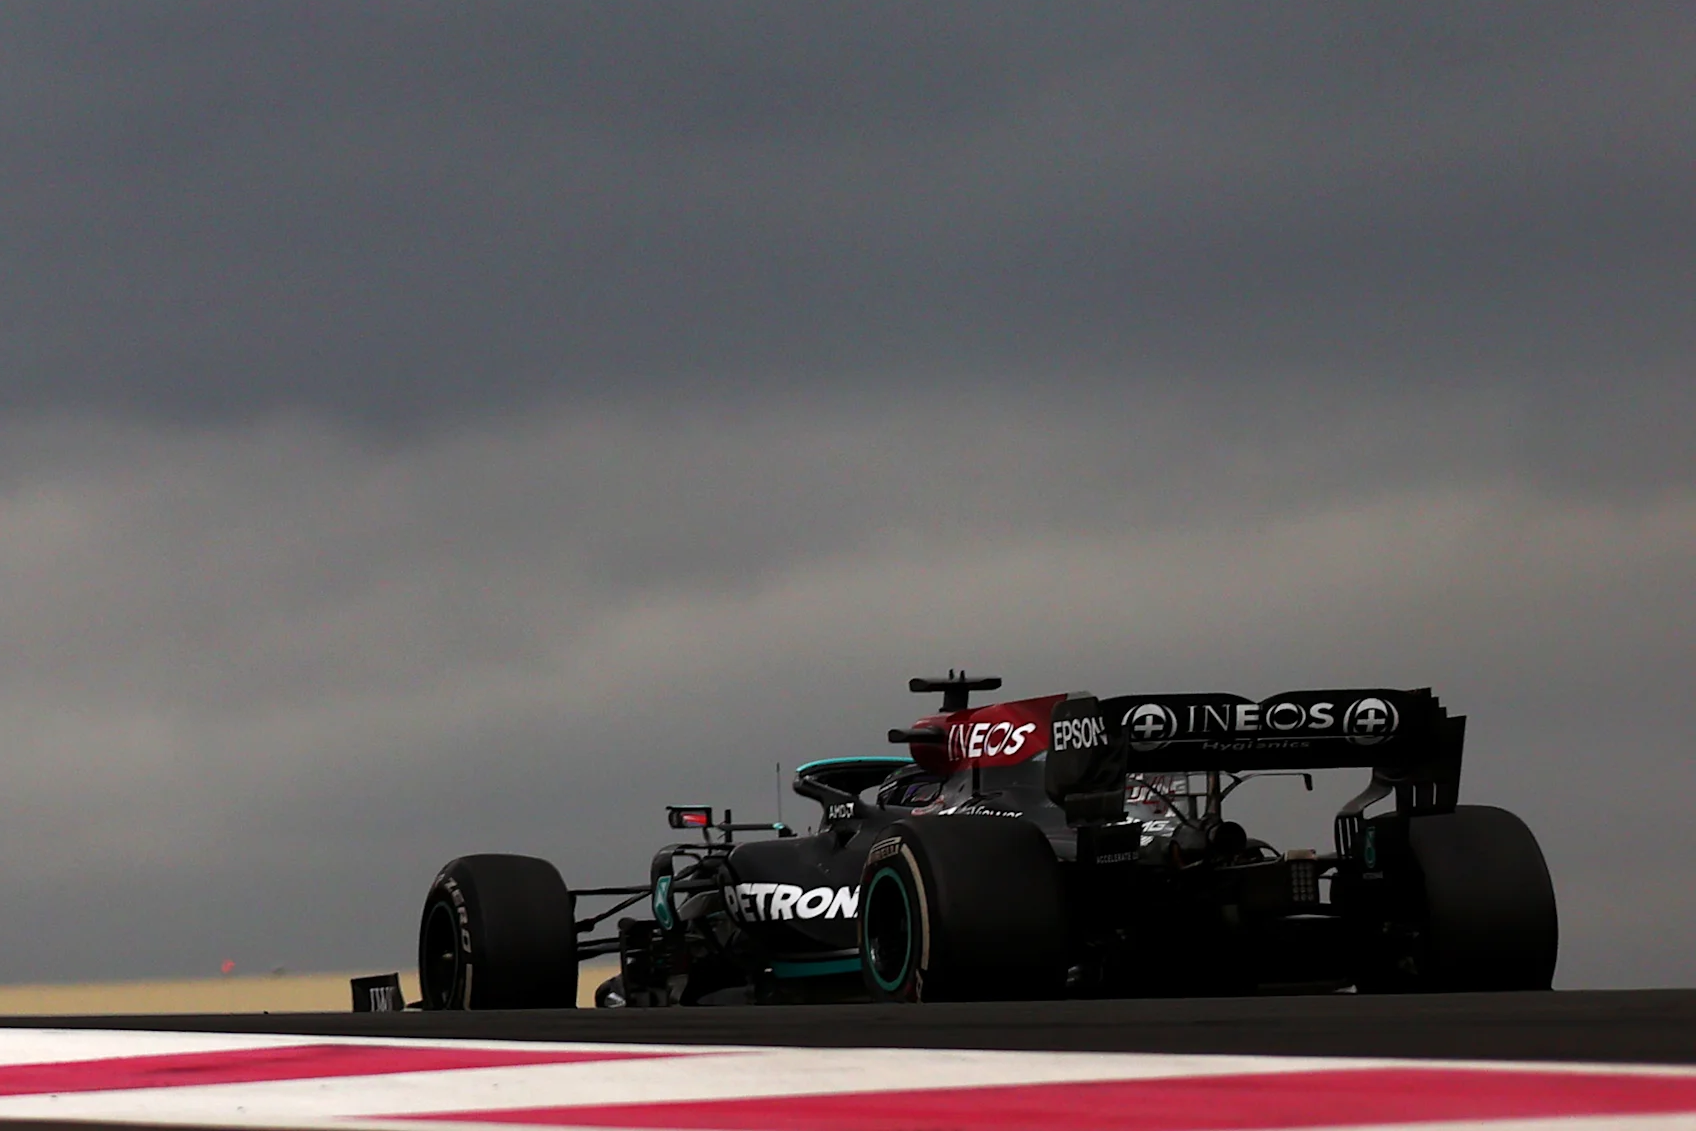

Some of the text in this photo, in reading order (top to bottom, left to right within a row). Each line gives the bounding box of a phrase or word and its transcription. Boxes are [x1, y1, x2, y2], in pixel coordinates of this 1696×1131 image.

[1053, 716, 1108, 752] EPSON
[1187, 702, 1334, 734] INEOS
[948, 722, 1036, 761] INEOS
[724, 882, 861, 922] PETRON
